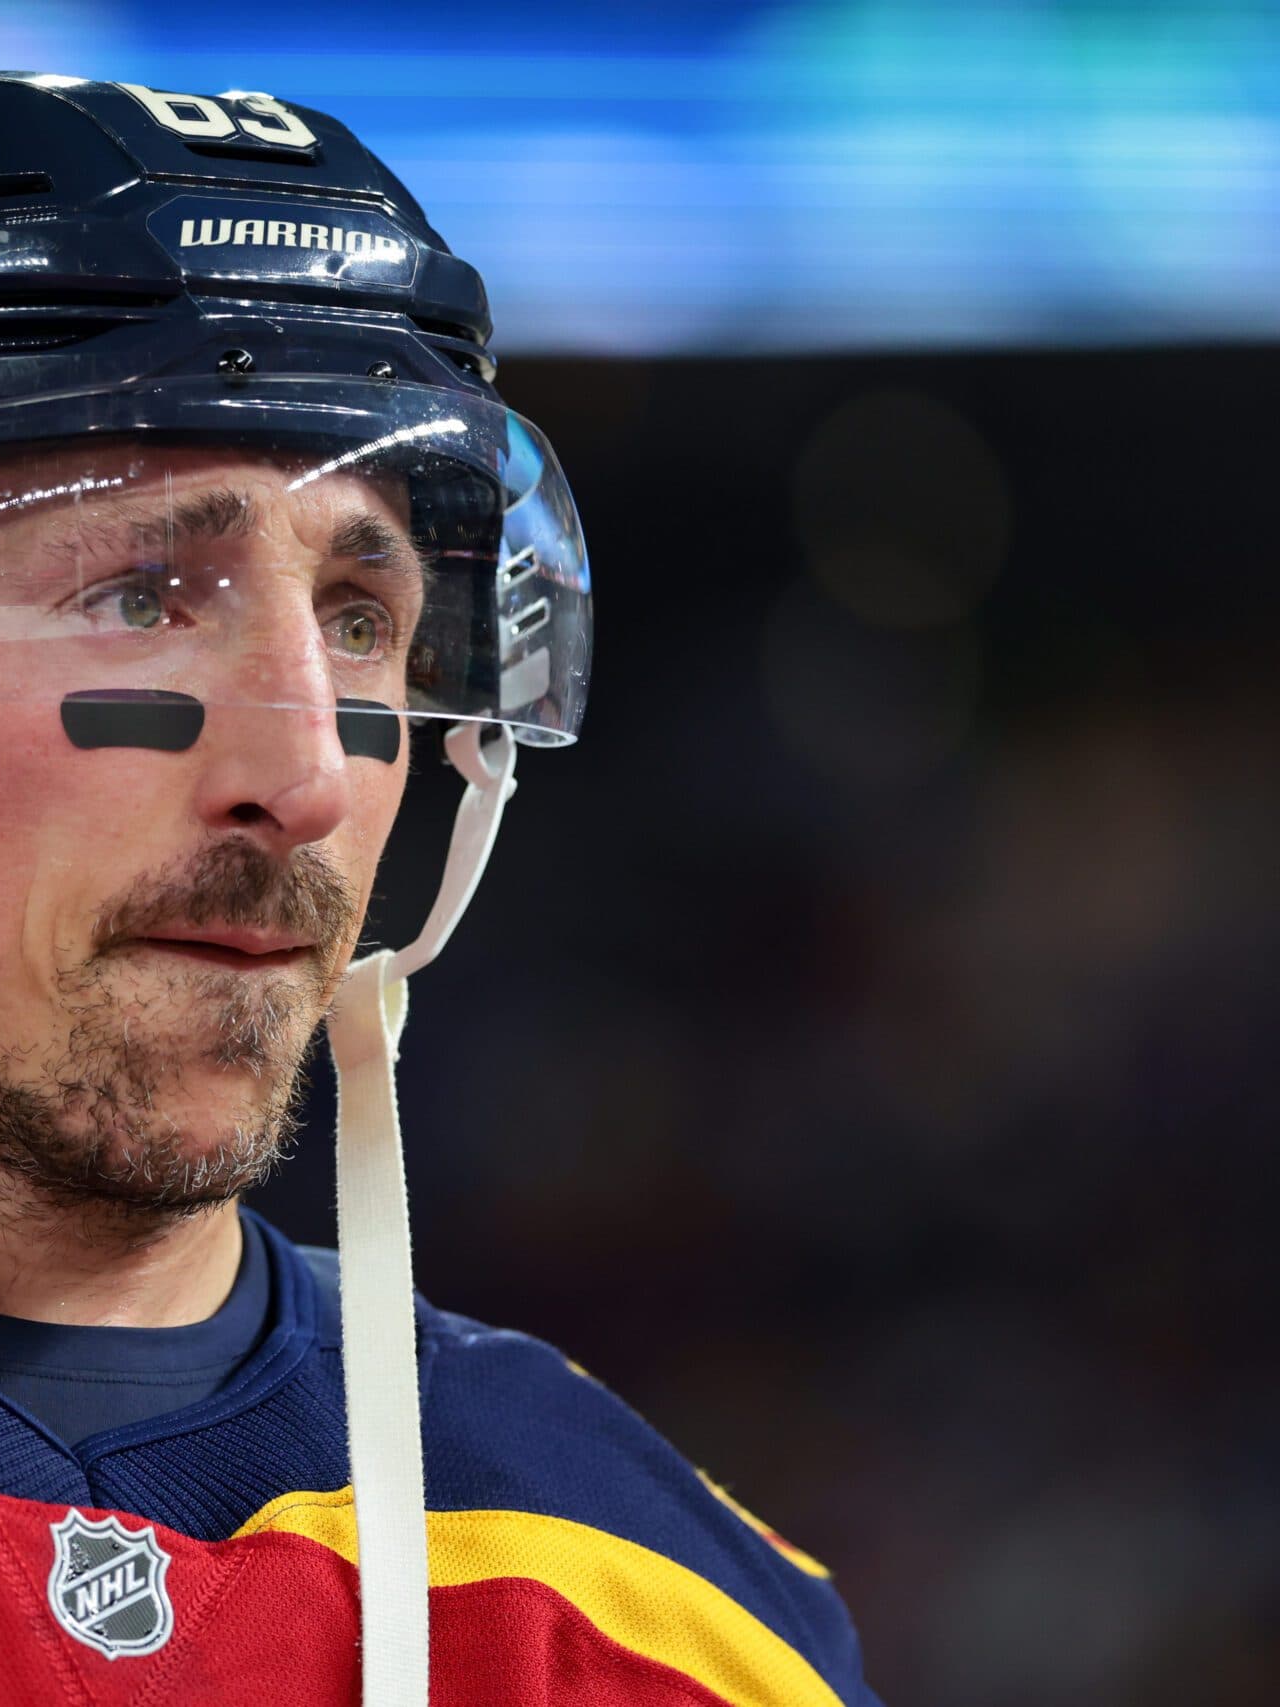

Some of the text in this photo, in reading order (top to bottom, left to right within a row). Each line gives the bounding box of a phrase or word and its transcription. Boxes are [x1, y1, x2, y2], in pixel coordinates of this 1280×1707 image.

[118, 82, 318, 148] 63
[180, 218, 407, 264] WARRIOR
[75, 1561, 146, 1619] NHL
